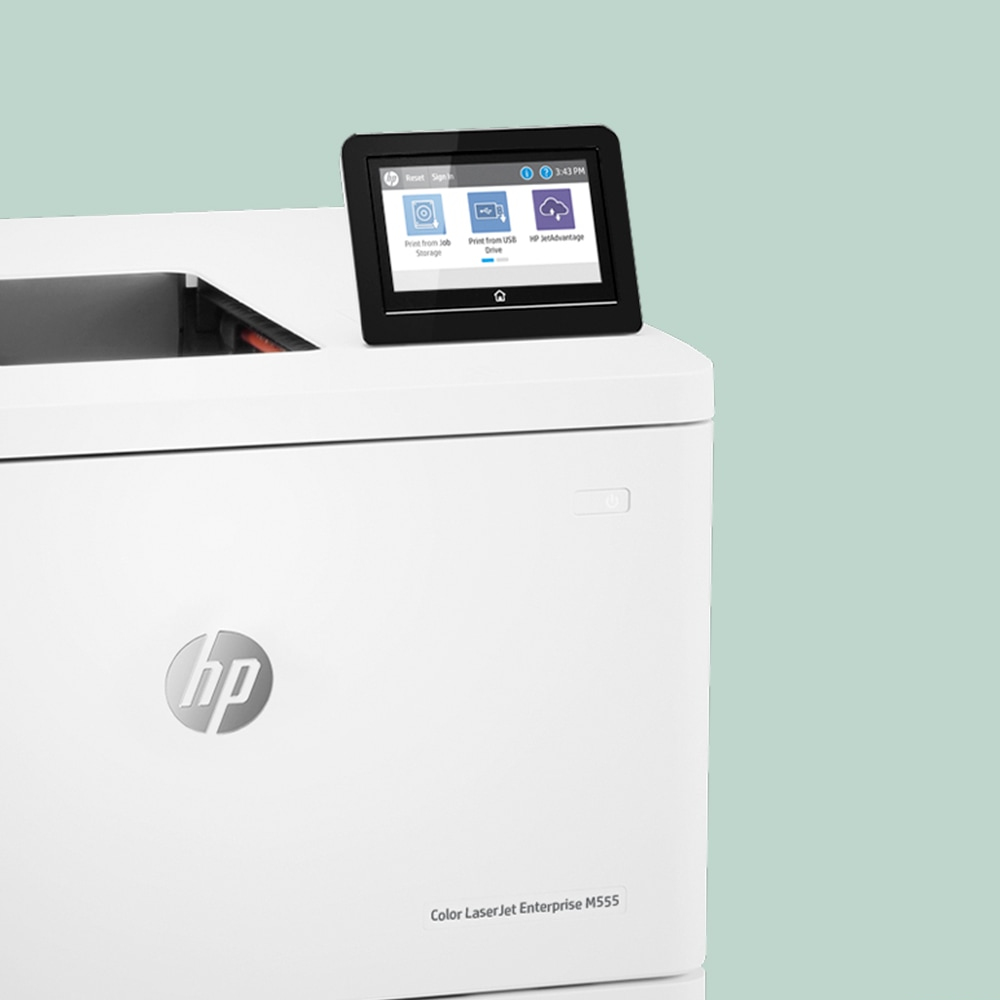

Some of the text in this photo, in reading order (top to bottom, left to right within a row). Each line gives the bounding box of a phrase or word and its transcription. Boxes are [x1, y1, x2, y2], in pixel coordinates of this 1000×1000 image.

[555, 166, 586, 177] 3:43 PM
[405, 173, 426, 182] Reset
[431, 172, 447, 183] Sign
[404, 238, 452, 249] Print from Job
[468, 235, 518, 246] Print from USB
[529, 234, 540, 243] HP
[416, 248, 442, 258] Storage
[484, 246, 503, 255] Drive
[430, 894, 620, 922] Color LaserJet Enterprise M555
